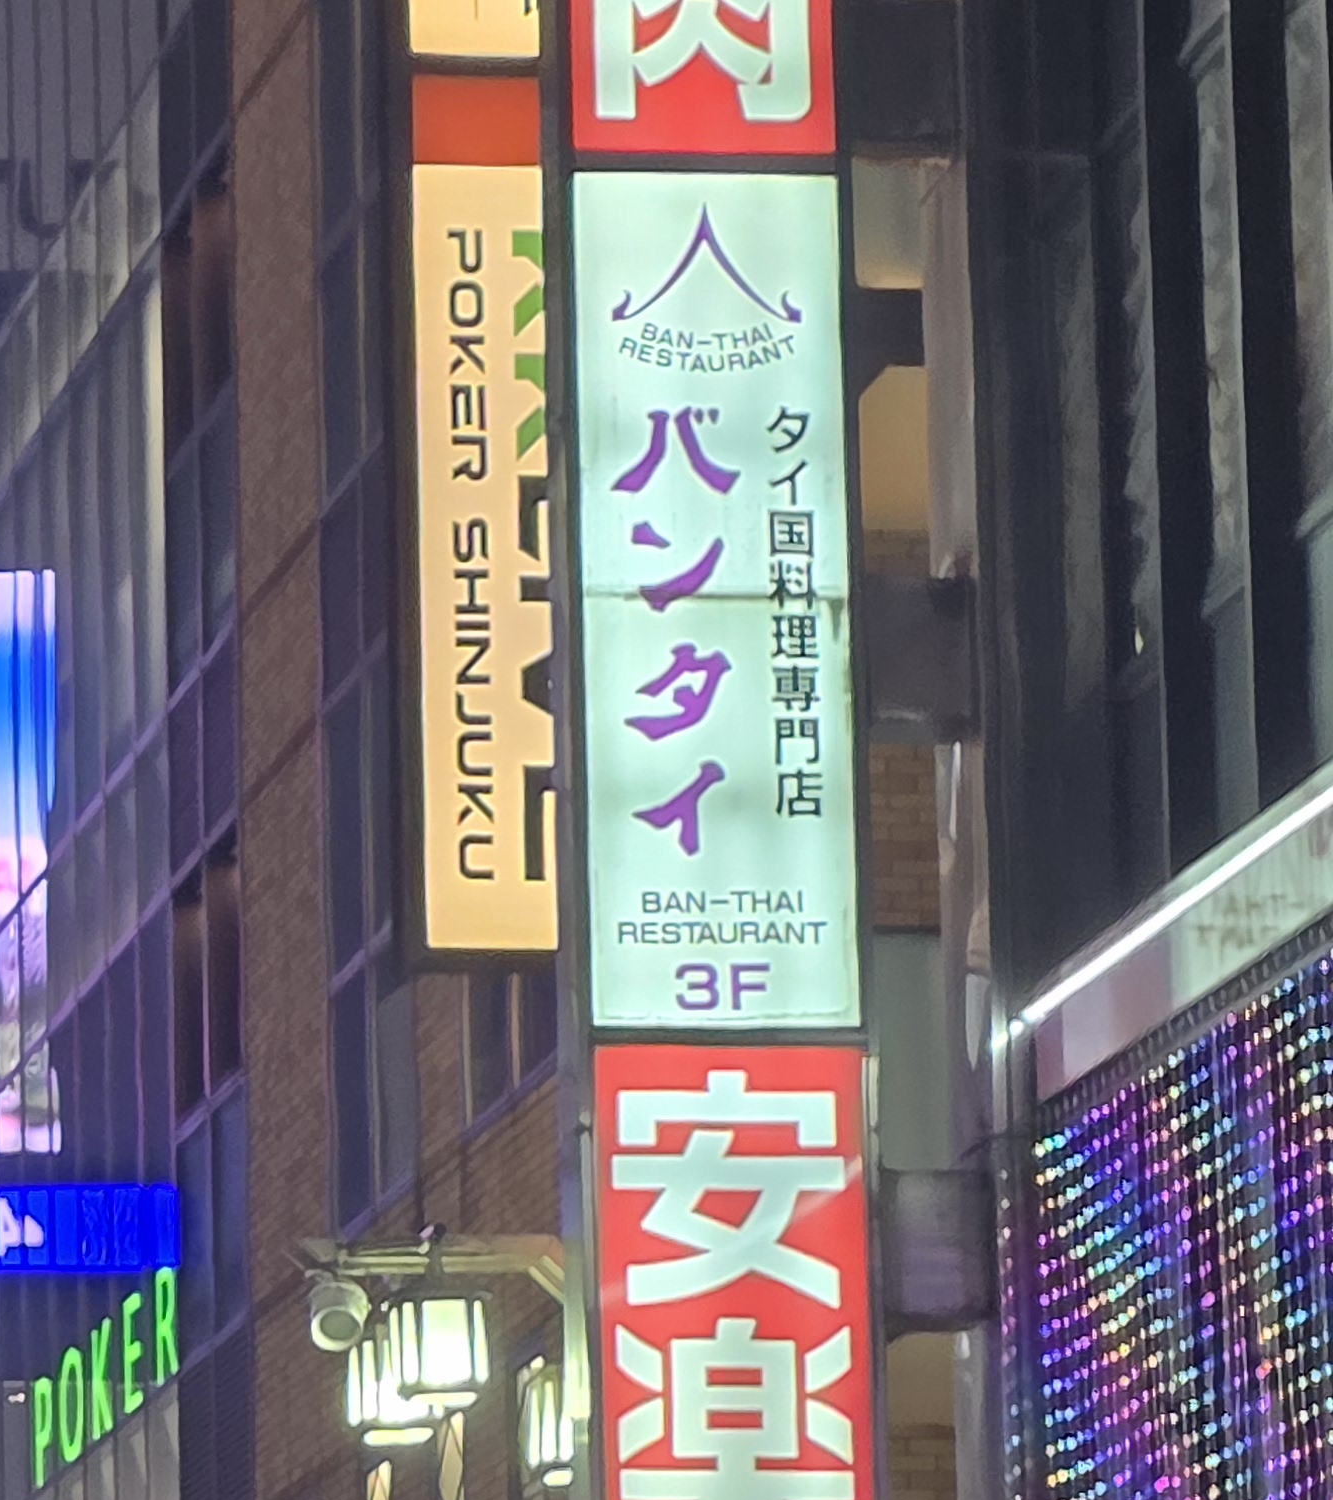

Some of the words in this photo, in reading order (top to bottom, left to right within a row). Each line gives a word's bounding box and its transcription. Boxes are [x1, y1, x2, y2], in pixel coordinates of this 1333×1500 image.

[446, 228, 492, 483] POKER
[618, 334, 800, 373] RESTAURANT
[640, 320, 775, 353] BAN-THAI
[610, 406, 742, 857] バンタイ
[764, 406, 825, 819] タイ国料理専門店
[450, 513, 497, 883] SHINJUKU
[617, 920, 828, 946] RESTAURANT
[640, 891, 806, 915] BAN-THAI
[674, 963, 771, 1011] 3F
[33, 1266, 179, 1490] POKER
